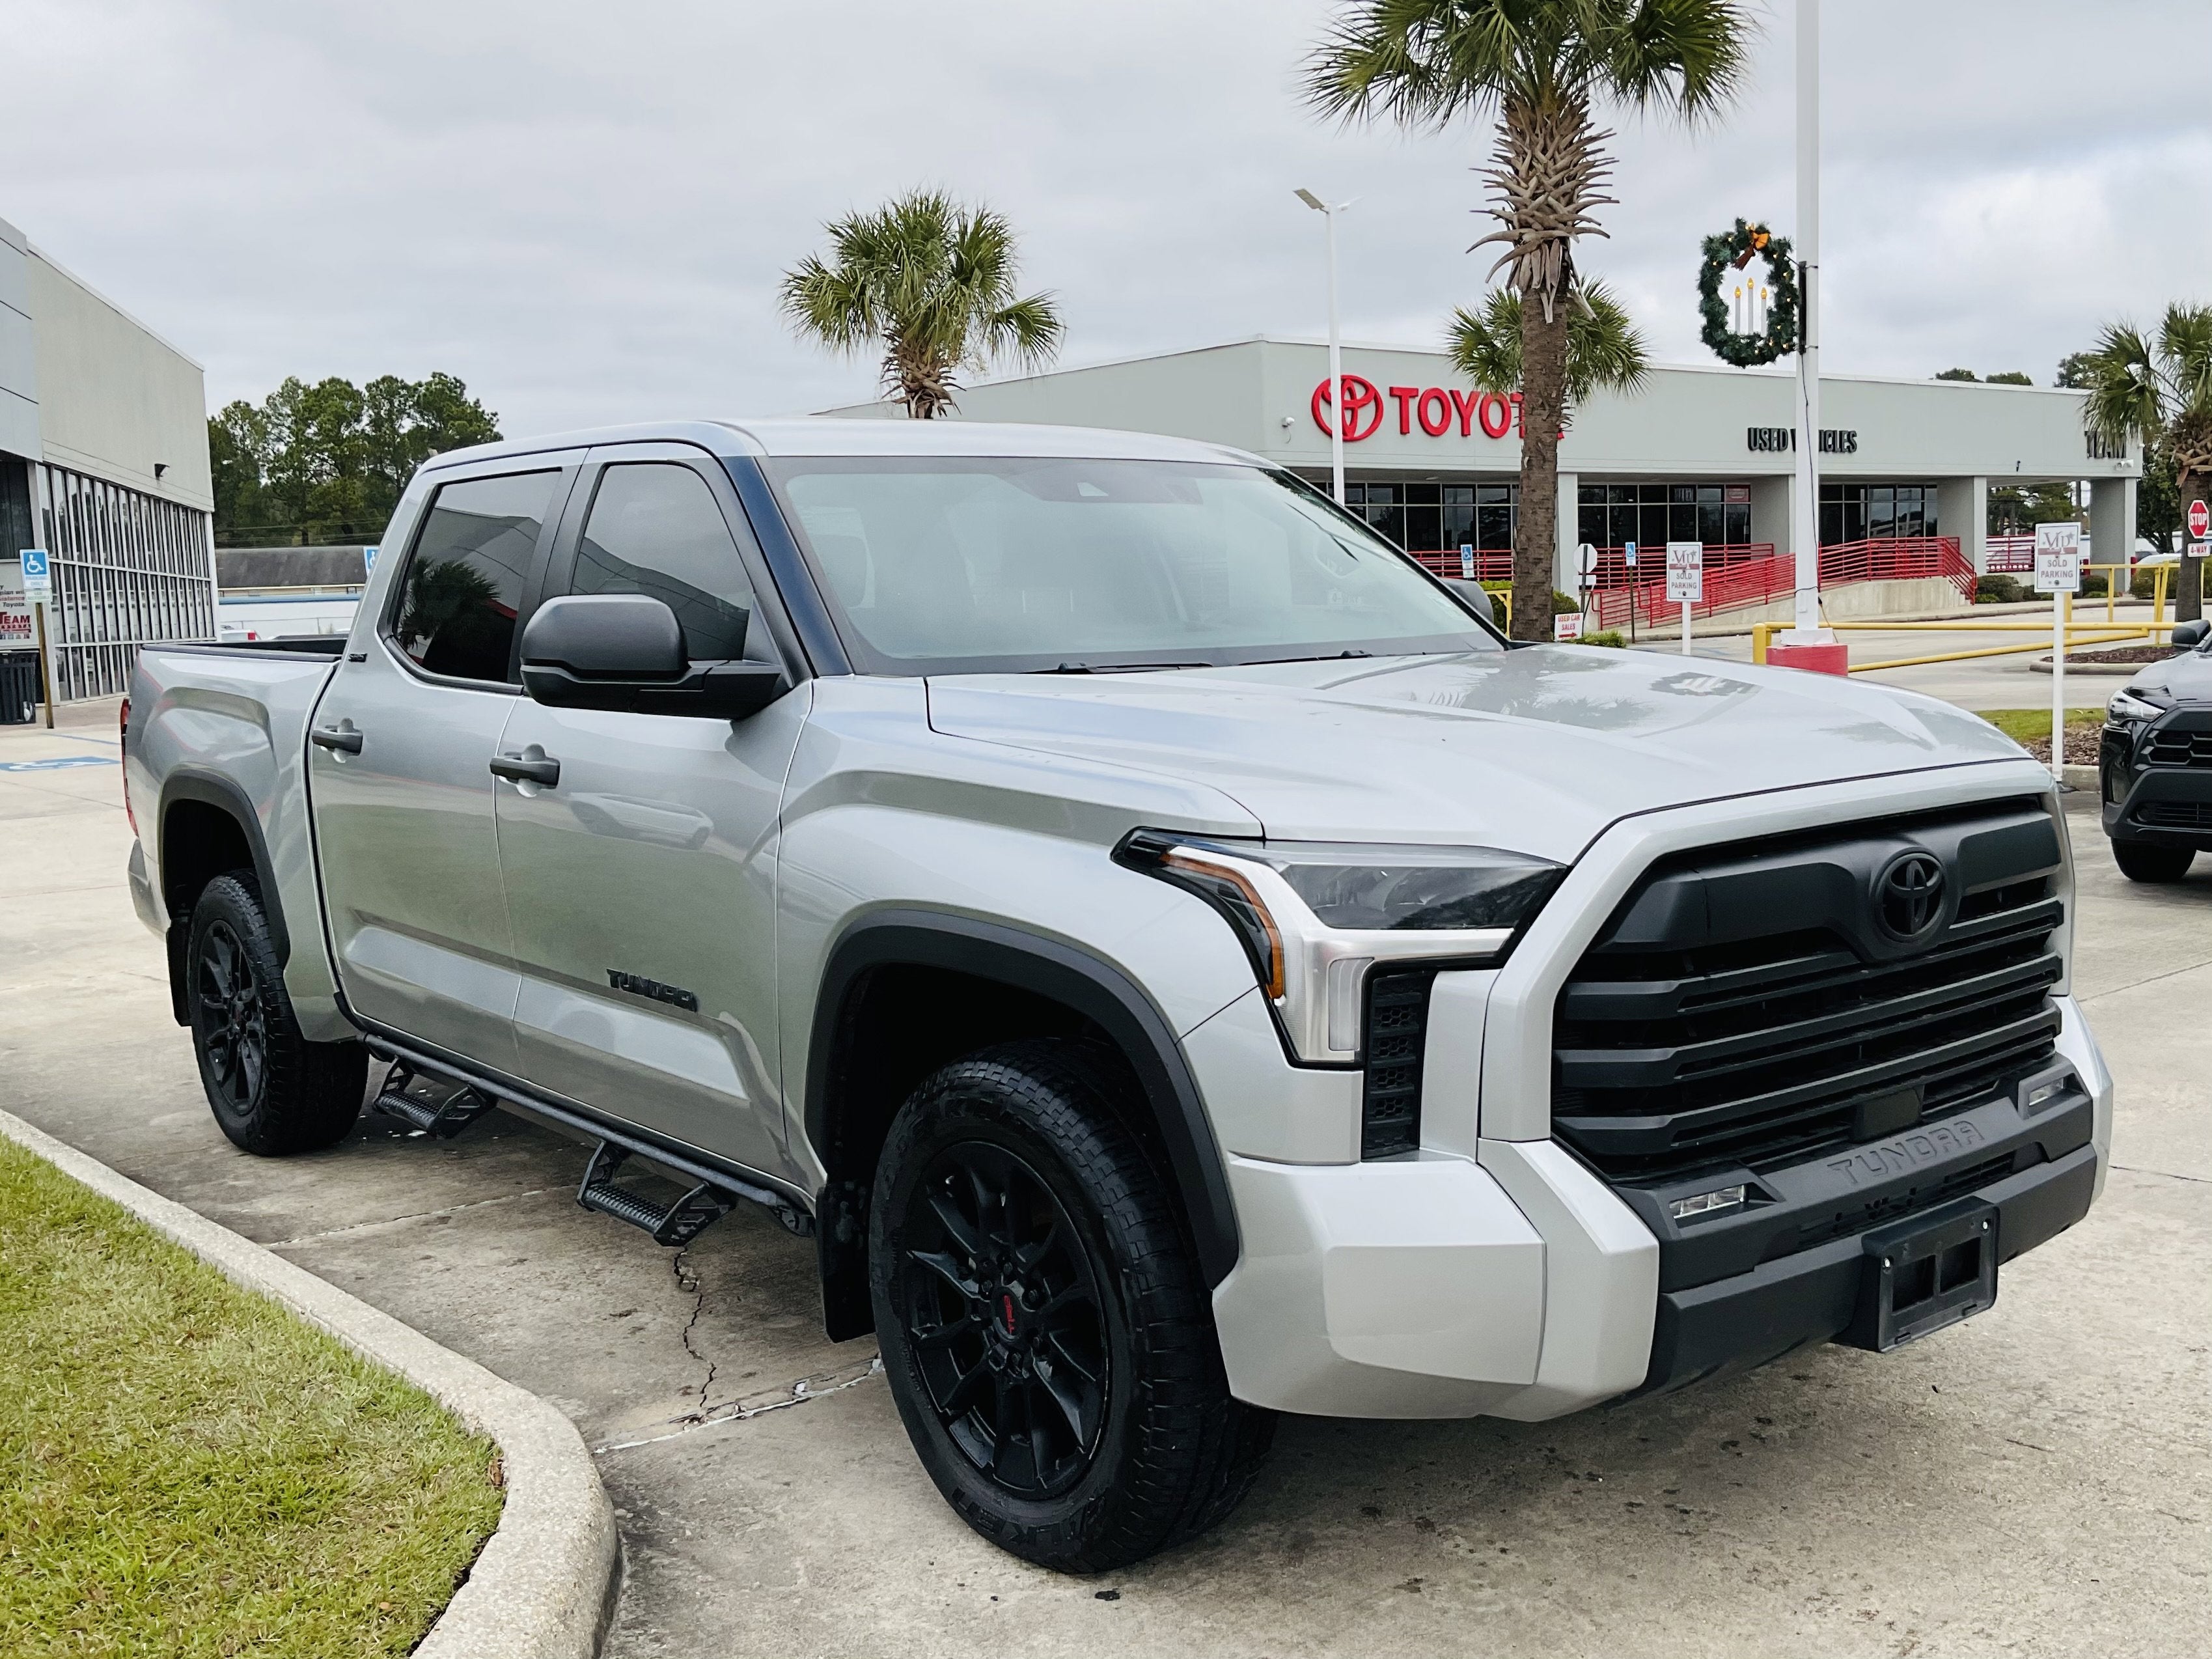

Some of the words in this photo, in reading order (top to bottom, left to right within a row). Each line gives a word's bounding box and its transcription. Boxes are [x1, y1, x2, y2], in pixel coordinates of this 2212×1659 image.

[1389, 386, 1564, 439] TOYOT
[1748, 427, 1788, 451] USED
[1790, 428, 1857, 453] VICLES
[2190, 512, 2207, 525] STOP
[1827, 1121, 1985, 1184] TUNDRA
